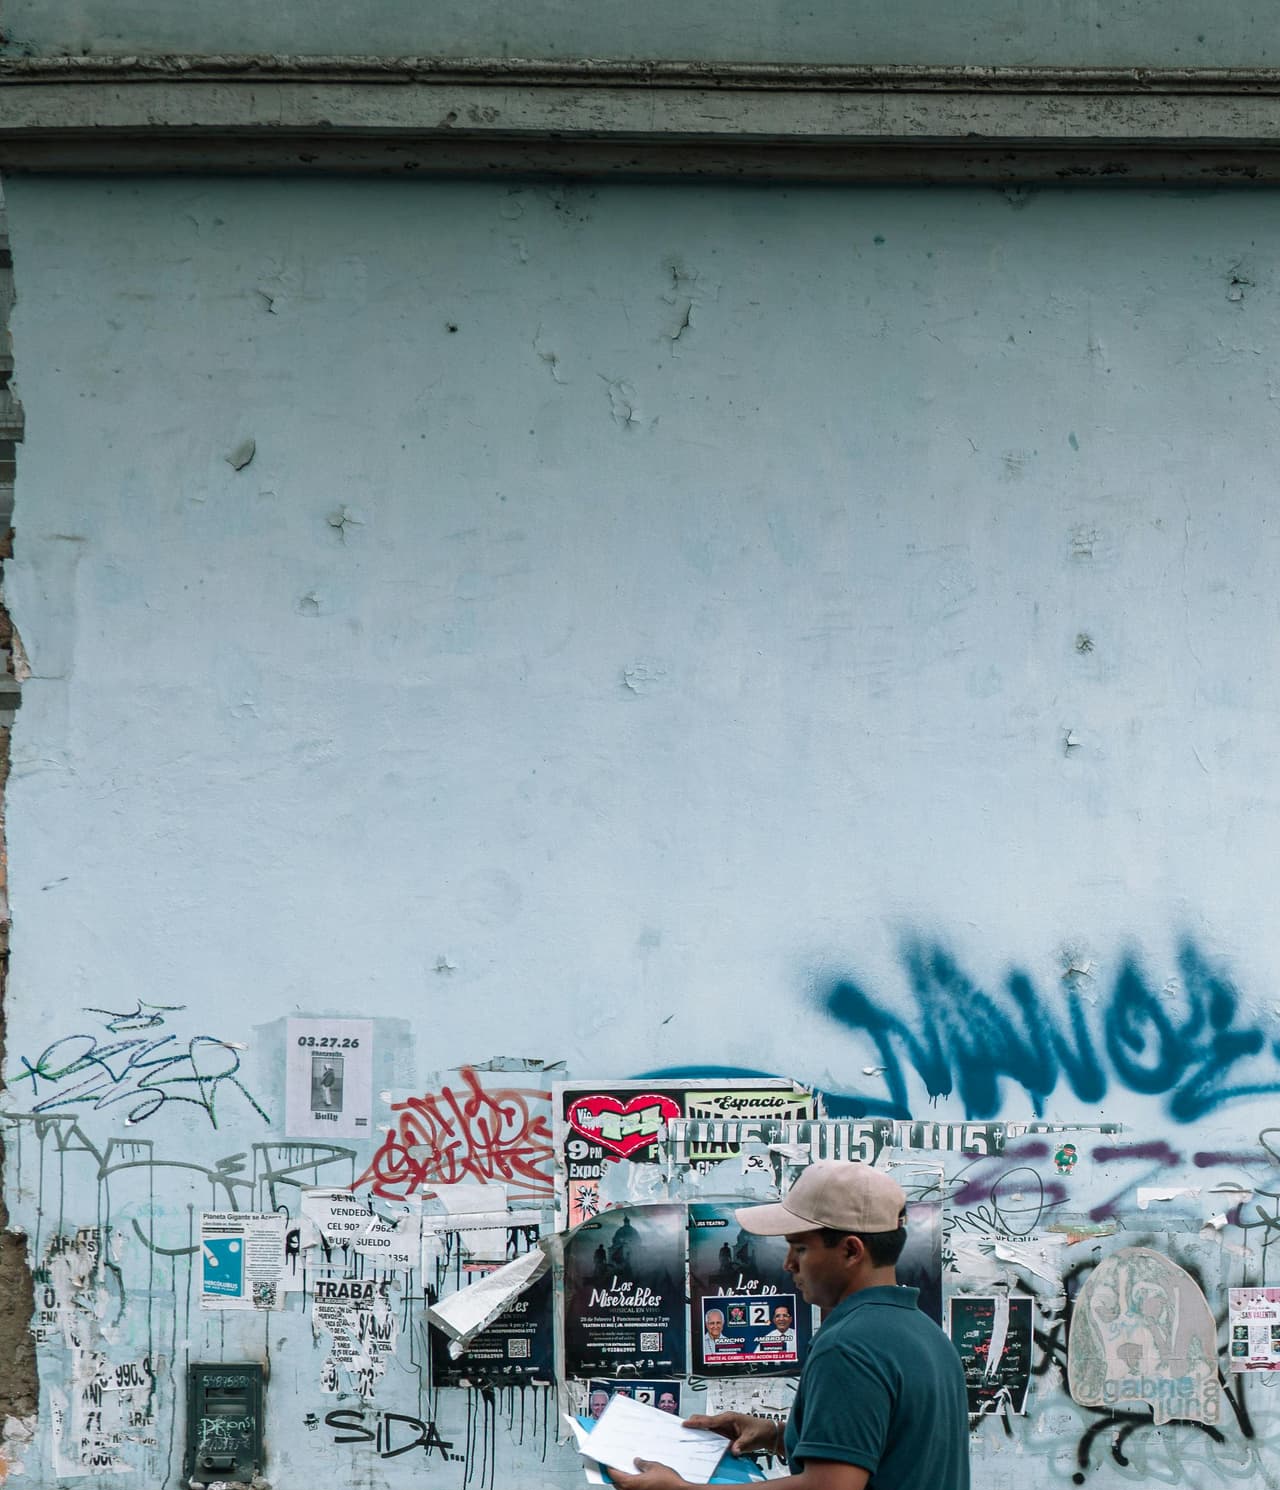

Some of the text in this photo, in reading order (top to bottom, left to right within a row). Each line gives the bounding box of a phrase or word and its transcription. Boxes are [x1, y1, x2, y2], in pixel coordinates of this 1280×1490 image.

[298, 1036, 360, 1049] 03.27.26
[714, 1095, 786, 1111] Espacio
[327, 1222, 343, 1231] CEL
[610, 1275, 633, 1292] Los
[735, 1273, 759, 1291] Los
[588, 1287, 662, 1308] Miserables
[754, 1307, 766, 1324] 2
